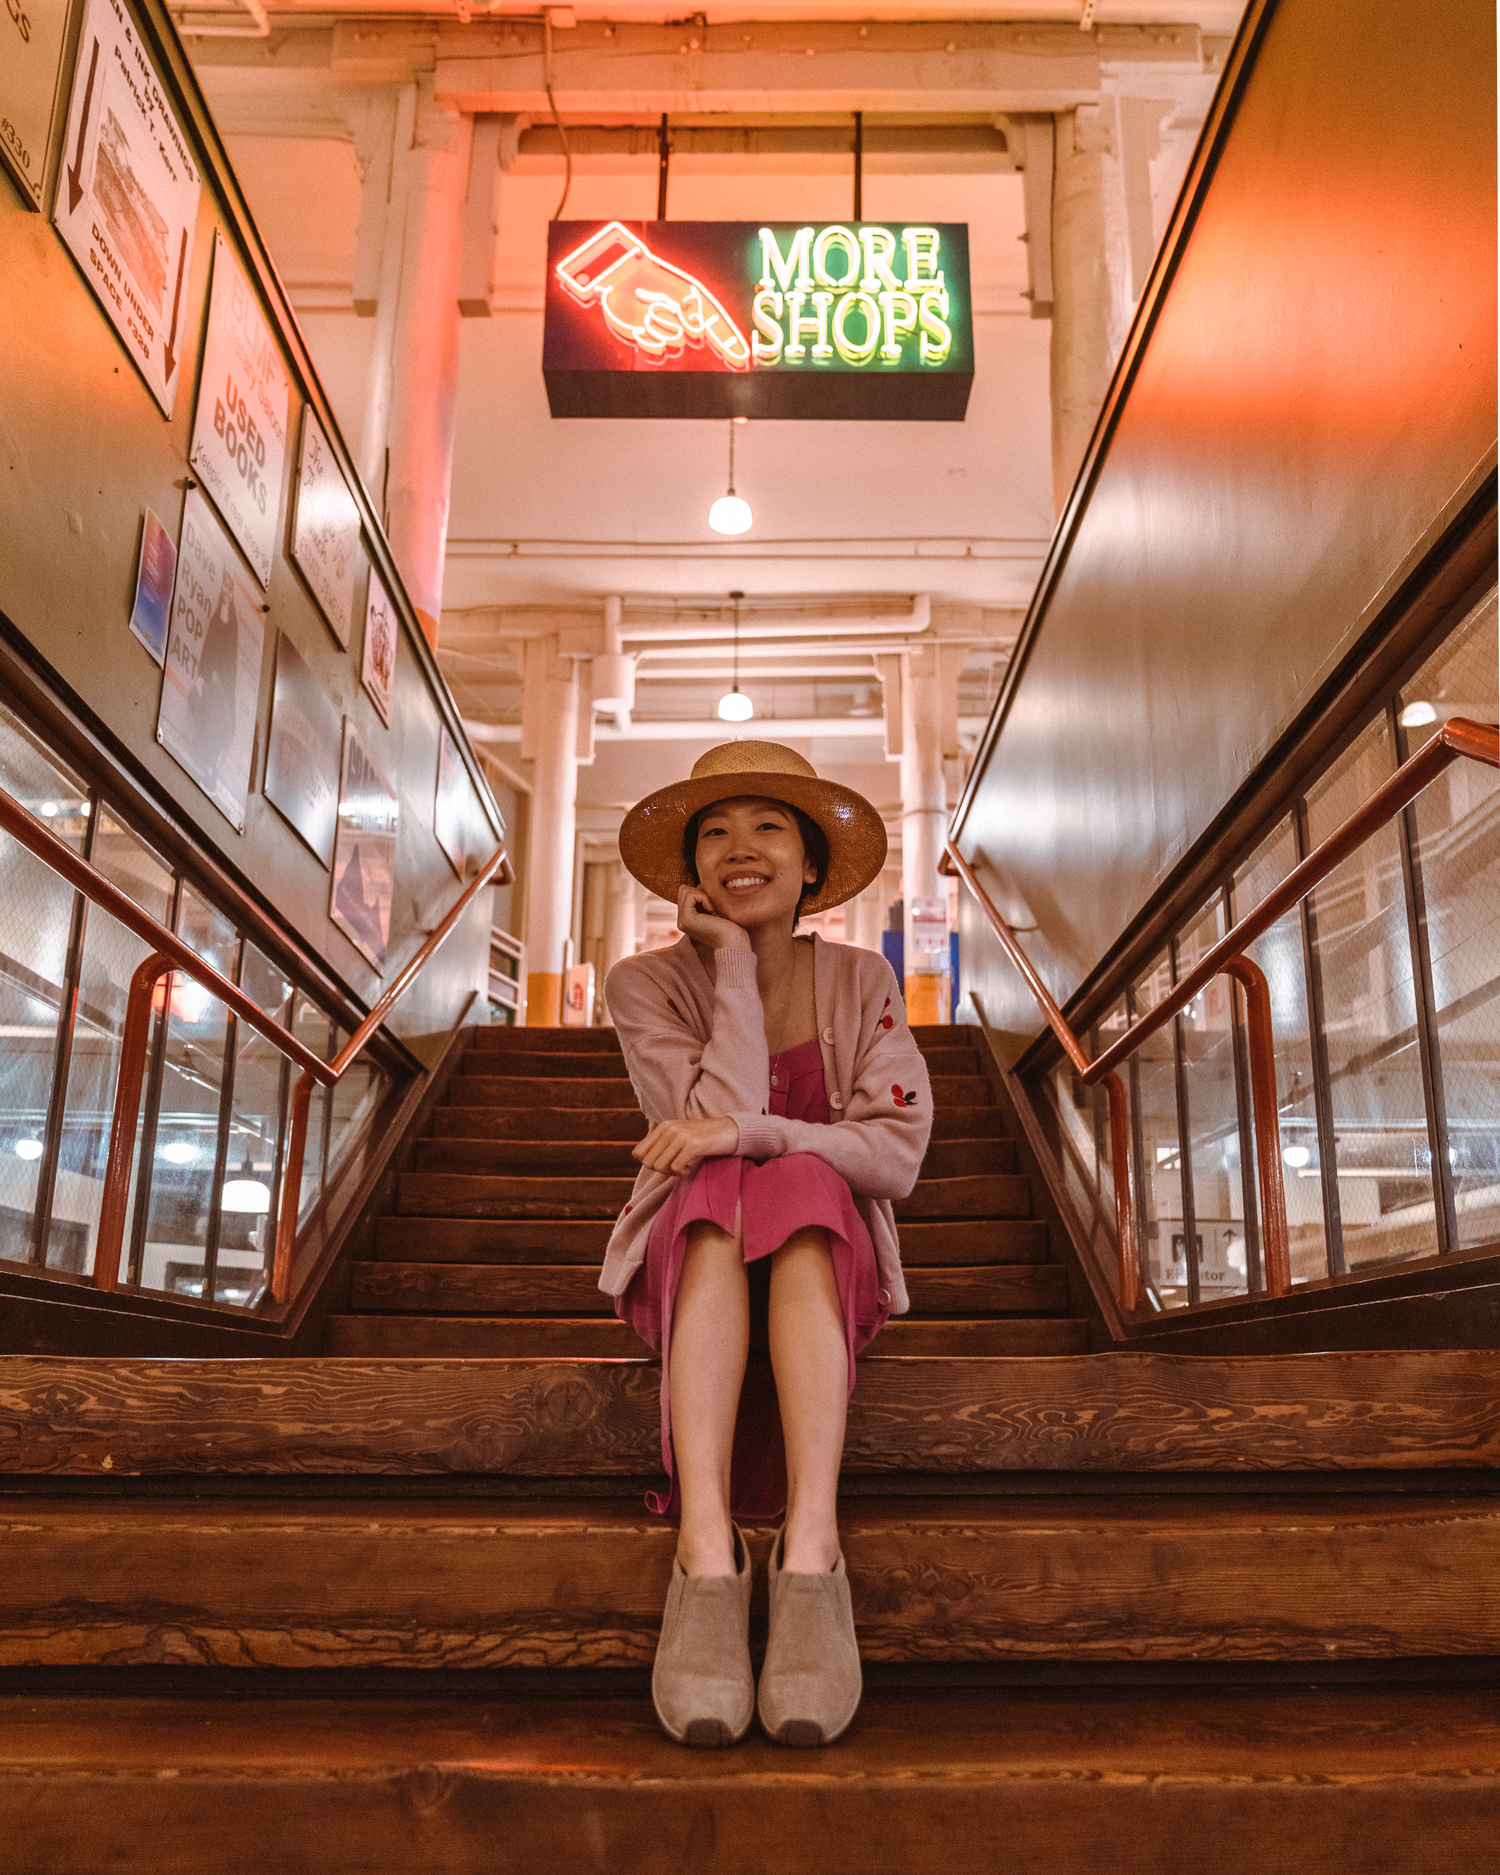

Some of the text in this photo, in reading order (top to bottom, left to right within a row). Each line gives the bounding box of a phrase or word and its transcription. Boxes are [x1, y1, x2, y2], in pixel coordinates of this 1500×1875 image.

[115, 44, 147, 119] Patrick
[159, 141, 177, 181] Kerr
[125, 27, 132, 45] &
[135, 46, 150, 85] INK
[153, 85, 193, 182] DRAWINGS
[144, 86, 154, 112] by
[2, 118, 30, 169] #330
[91, 222, 155, 342] DOWN UNDER
[758, 225, 945, 292] MORE
[90, 247, 150, 360] SPACE #328
[231, 273, 277, 386] BLMF
[752, 290, 952, 362] SHOPS
[213, 396, 268, 516] BOOKS
[226, 373, 265, 470] USED
[186, 519, 216, 583] Dave
[176, 594, 203, 642] POP
[181, 556, 211, 619] Ryan
[170, 633, 199, 680] ART
[1165, 1268, 1226, 1281] Eltor
